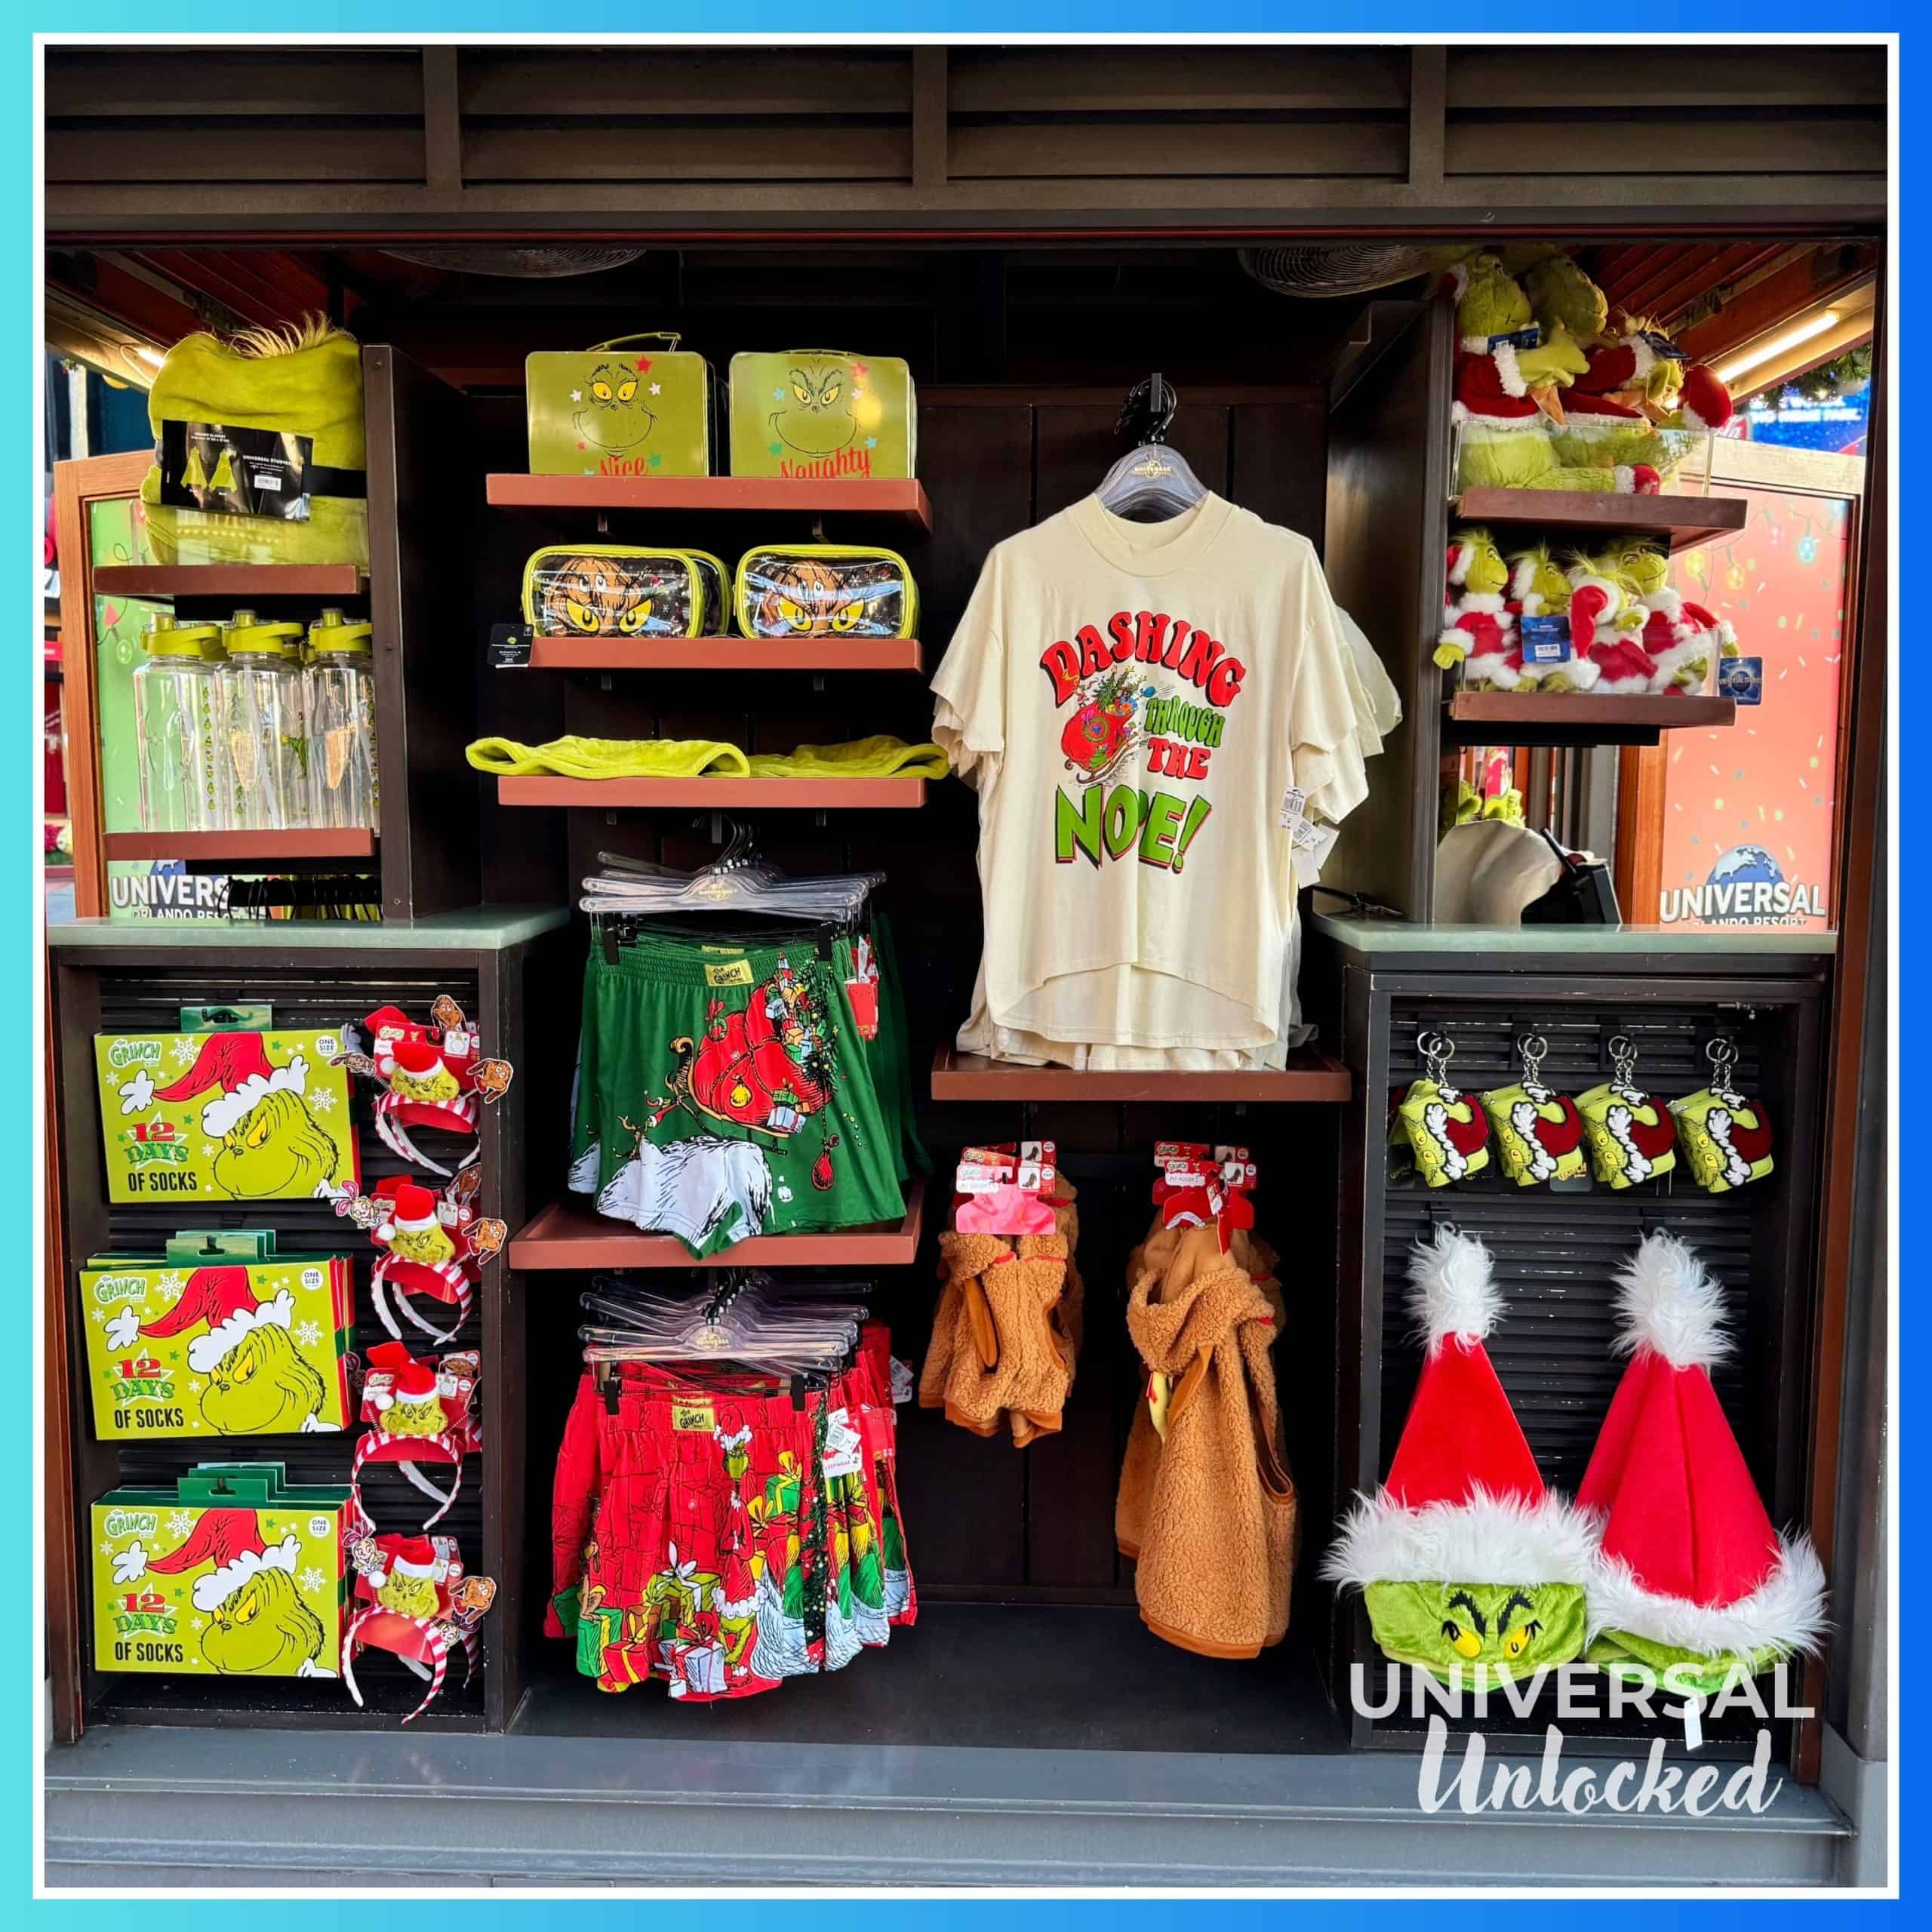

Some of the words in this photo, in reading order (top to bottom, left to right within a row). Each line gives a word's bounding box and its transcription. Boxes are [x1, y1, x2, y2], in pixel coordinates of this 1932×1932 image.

[599, 456, 648, 476] Nice
[780, 448, 872, 478] Naughty
[1040, 611, 1246, 708] DASHING
[1144, 695, 1226, 747] THROUGH
[1147, 737, 1211, 780] THE
[112, 875, 230, 911] UNIVERS
[1660, 881, 1826, 922] UNIVERSAL
[713, 967, 742, 984] GRINCH
[109, 1041, 162, 1067] GRINCH
[131, 1122, 175, 1142] 12
[123, 1143, 189, 1164] DAYS
[128, 1172, 145, 1191] OF
[149, 1171, 198, 1191] SOCKS
[95, 1278, 146, 1303] GRINCH
[118, 1358, 162, 1378] 12
[109, 1379, 176, 1401] DAYS
[114, 1409, 131, 1429] OF
[136, 1407, 184, 1428] SOCKS
[680, 1413, 705, 1429] GRINCH
[106, 1514, 156, 1537] GRINCH
[122, 1593, 165, 1613] 12
[112, 1614, 177, 1635] DAYS
[115, 1641, 132, 1660] OF
[136, 1642, 183, 1663] SOCKS
